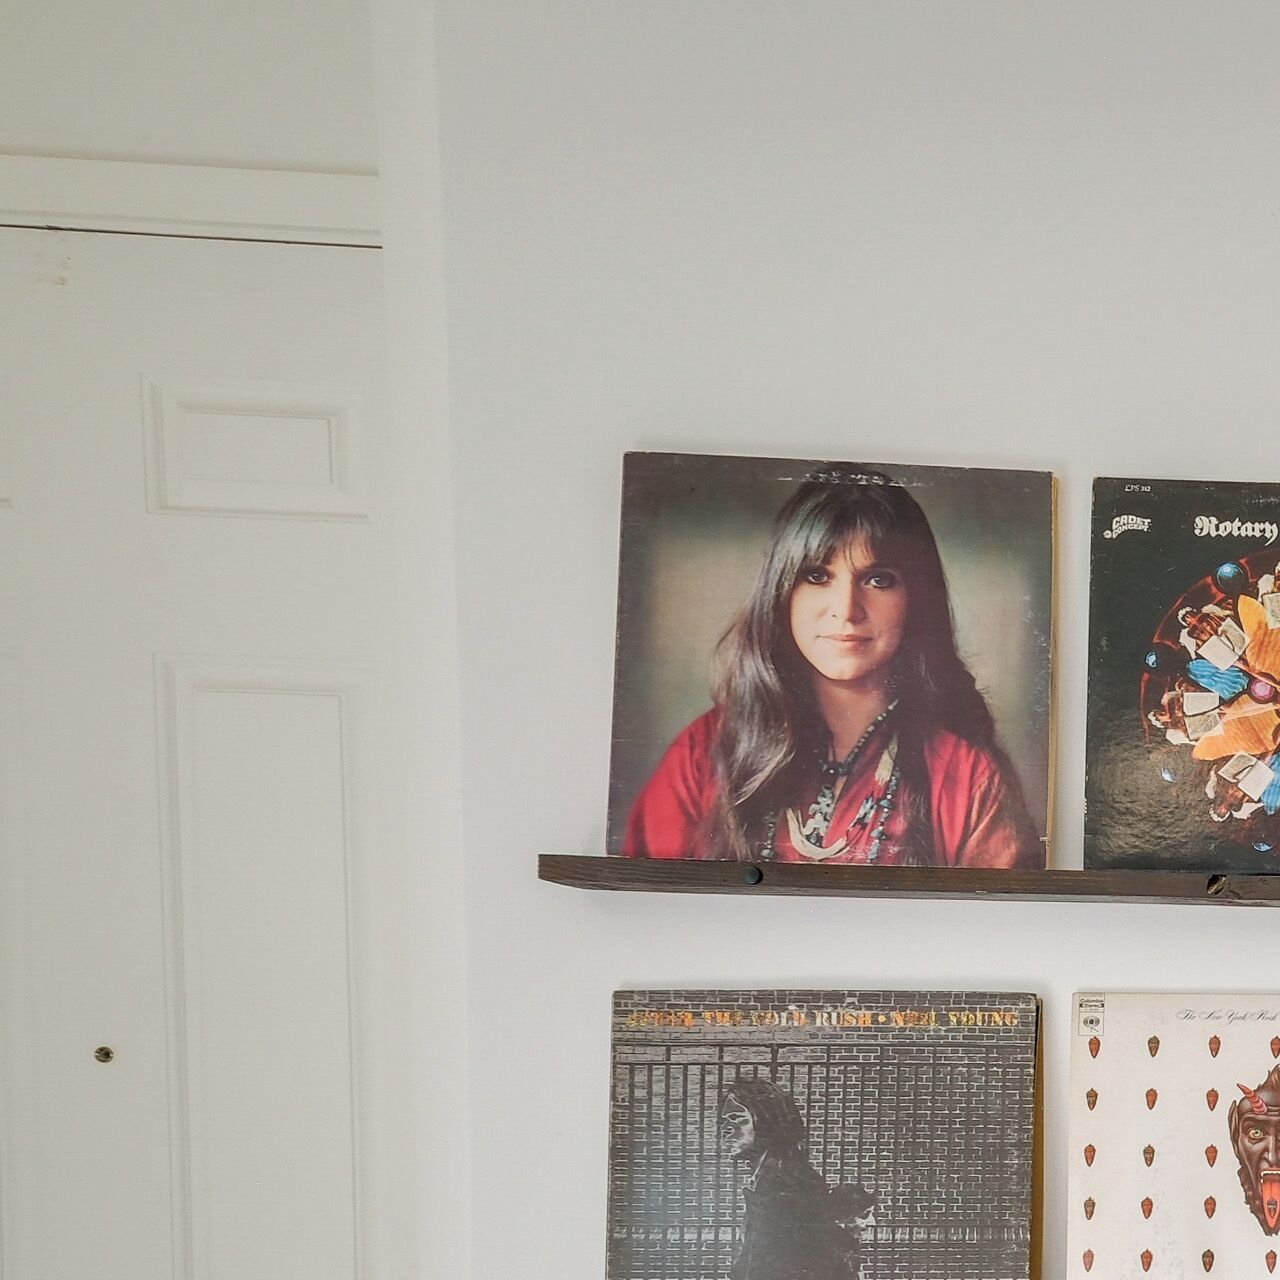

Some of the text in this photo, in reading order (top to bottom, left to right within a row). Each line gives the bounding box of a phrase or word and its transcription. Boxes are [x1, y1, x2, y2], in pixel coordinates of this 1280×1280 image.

[1112, 515, 1151, 530] CADET
[1193, 515, 1278, 546] Rotary
[813, 1010, 872, 1027] RUSH
[948, 1011, 1019, 1027] YOUNG
[1175, 1009, 1197, 1021] The
[1225, 1008, 1250, 1025] York
